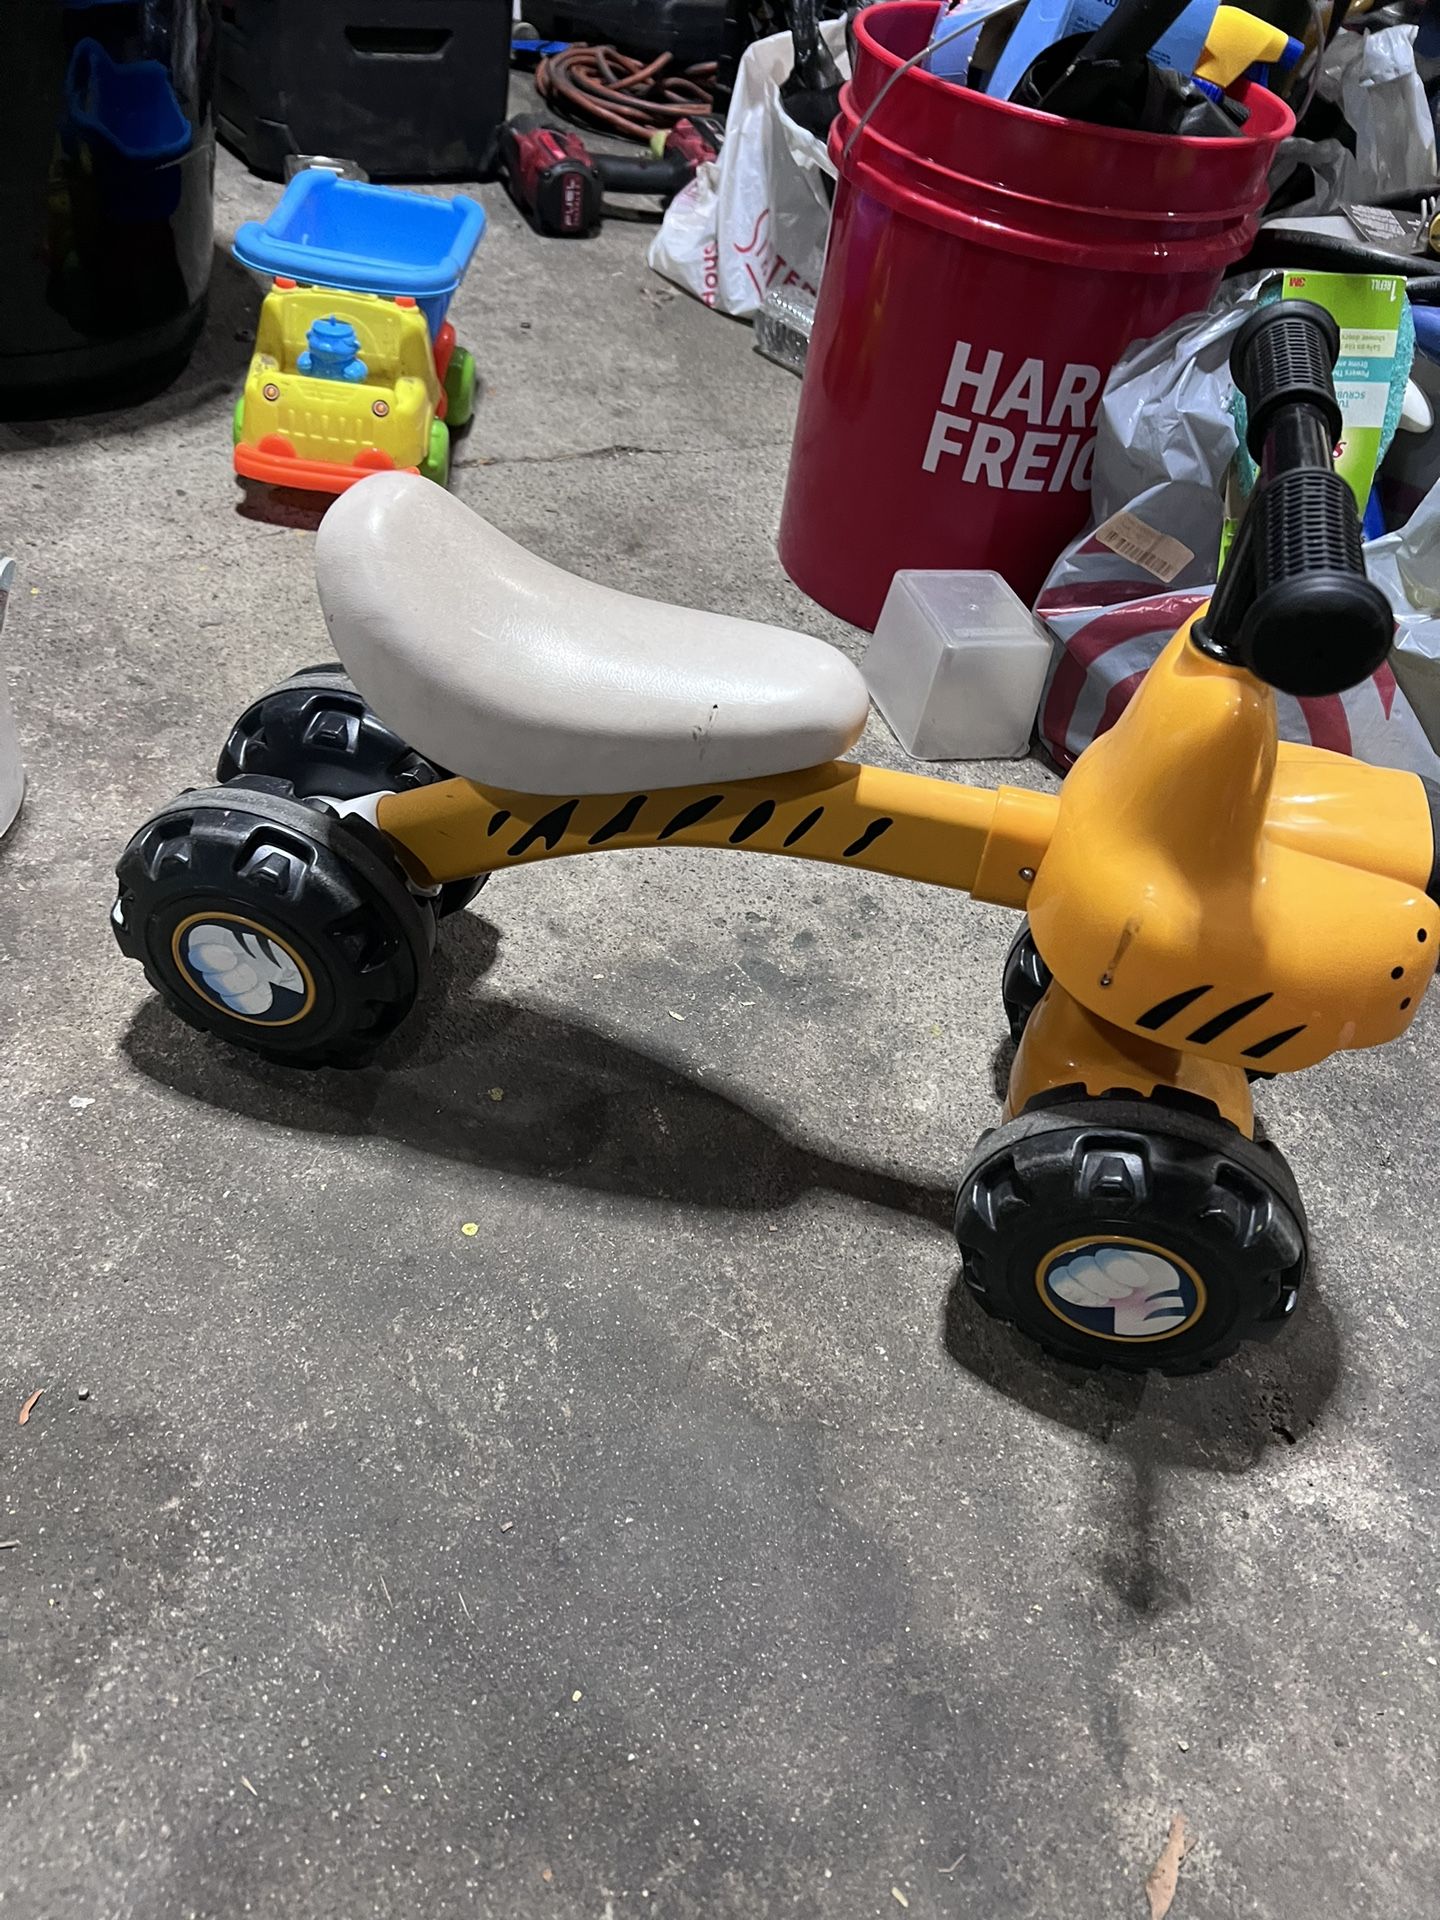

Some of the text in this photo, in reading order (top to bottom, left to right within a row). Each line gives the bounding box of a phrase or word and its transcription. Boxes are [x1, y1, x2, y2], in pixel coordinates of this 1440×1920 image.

[1289, 277, 1306, 287] 3M
[1371, 279, 1392, 291] REFILL
[1390, 280, 1397, 302] 1
[1344, 369, 1370, 378] Powers
[1335, 391, 1366, 400] SCRUB
